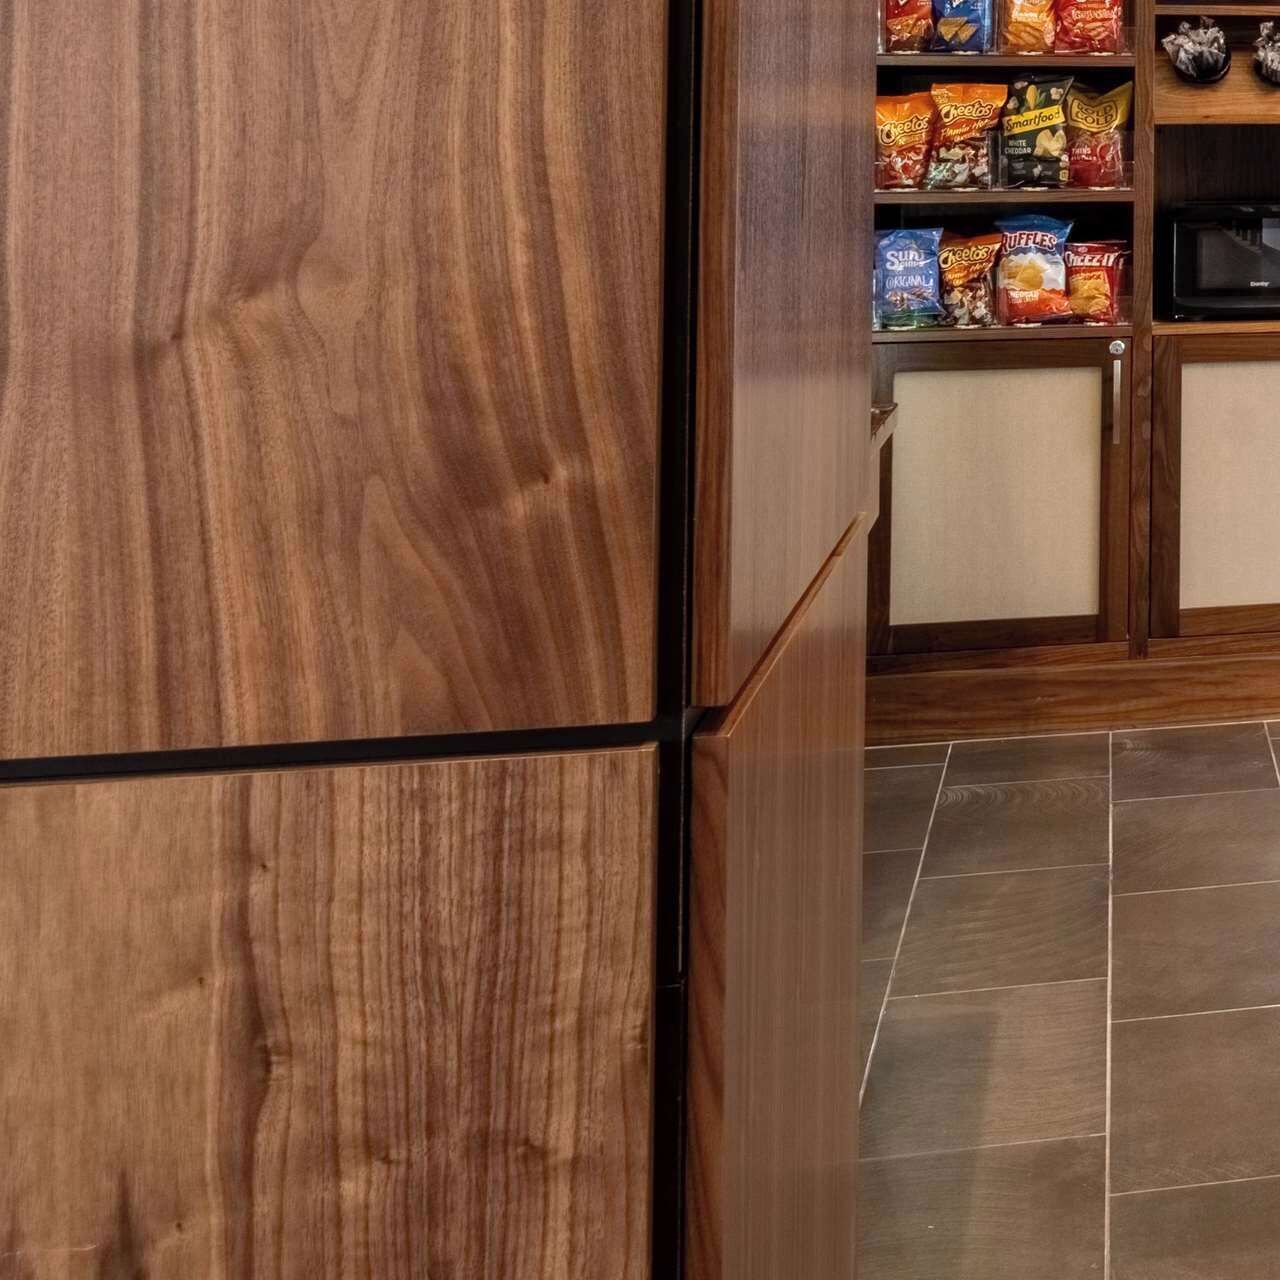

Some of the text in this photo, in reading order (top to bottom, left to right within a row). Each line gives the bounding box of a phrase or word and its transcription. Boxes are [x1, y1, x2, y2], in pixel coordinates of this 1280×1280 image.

[941, 100, 993, 124] Cheetos
[1006, 107, 1062, 132] Smartfood
[879, 115, 929, 144] Cheetos
[1000, 231, 1057, 254] RUFFLES
[939, 245, 989, 269] Cheetos
